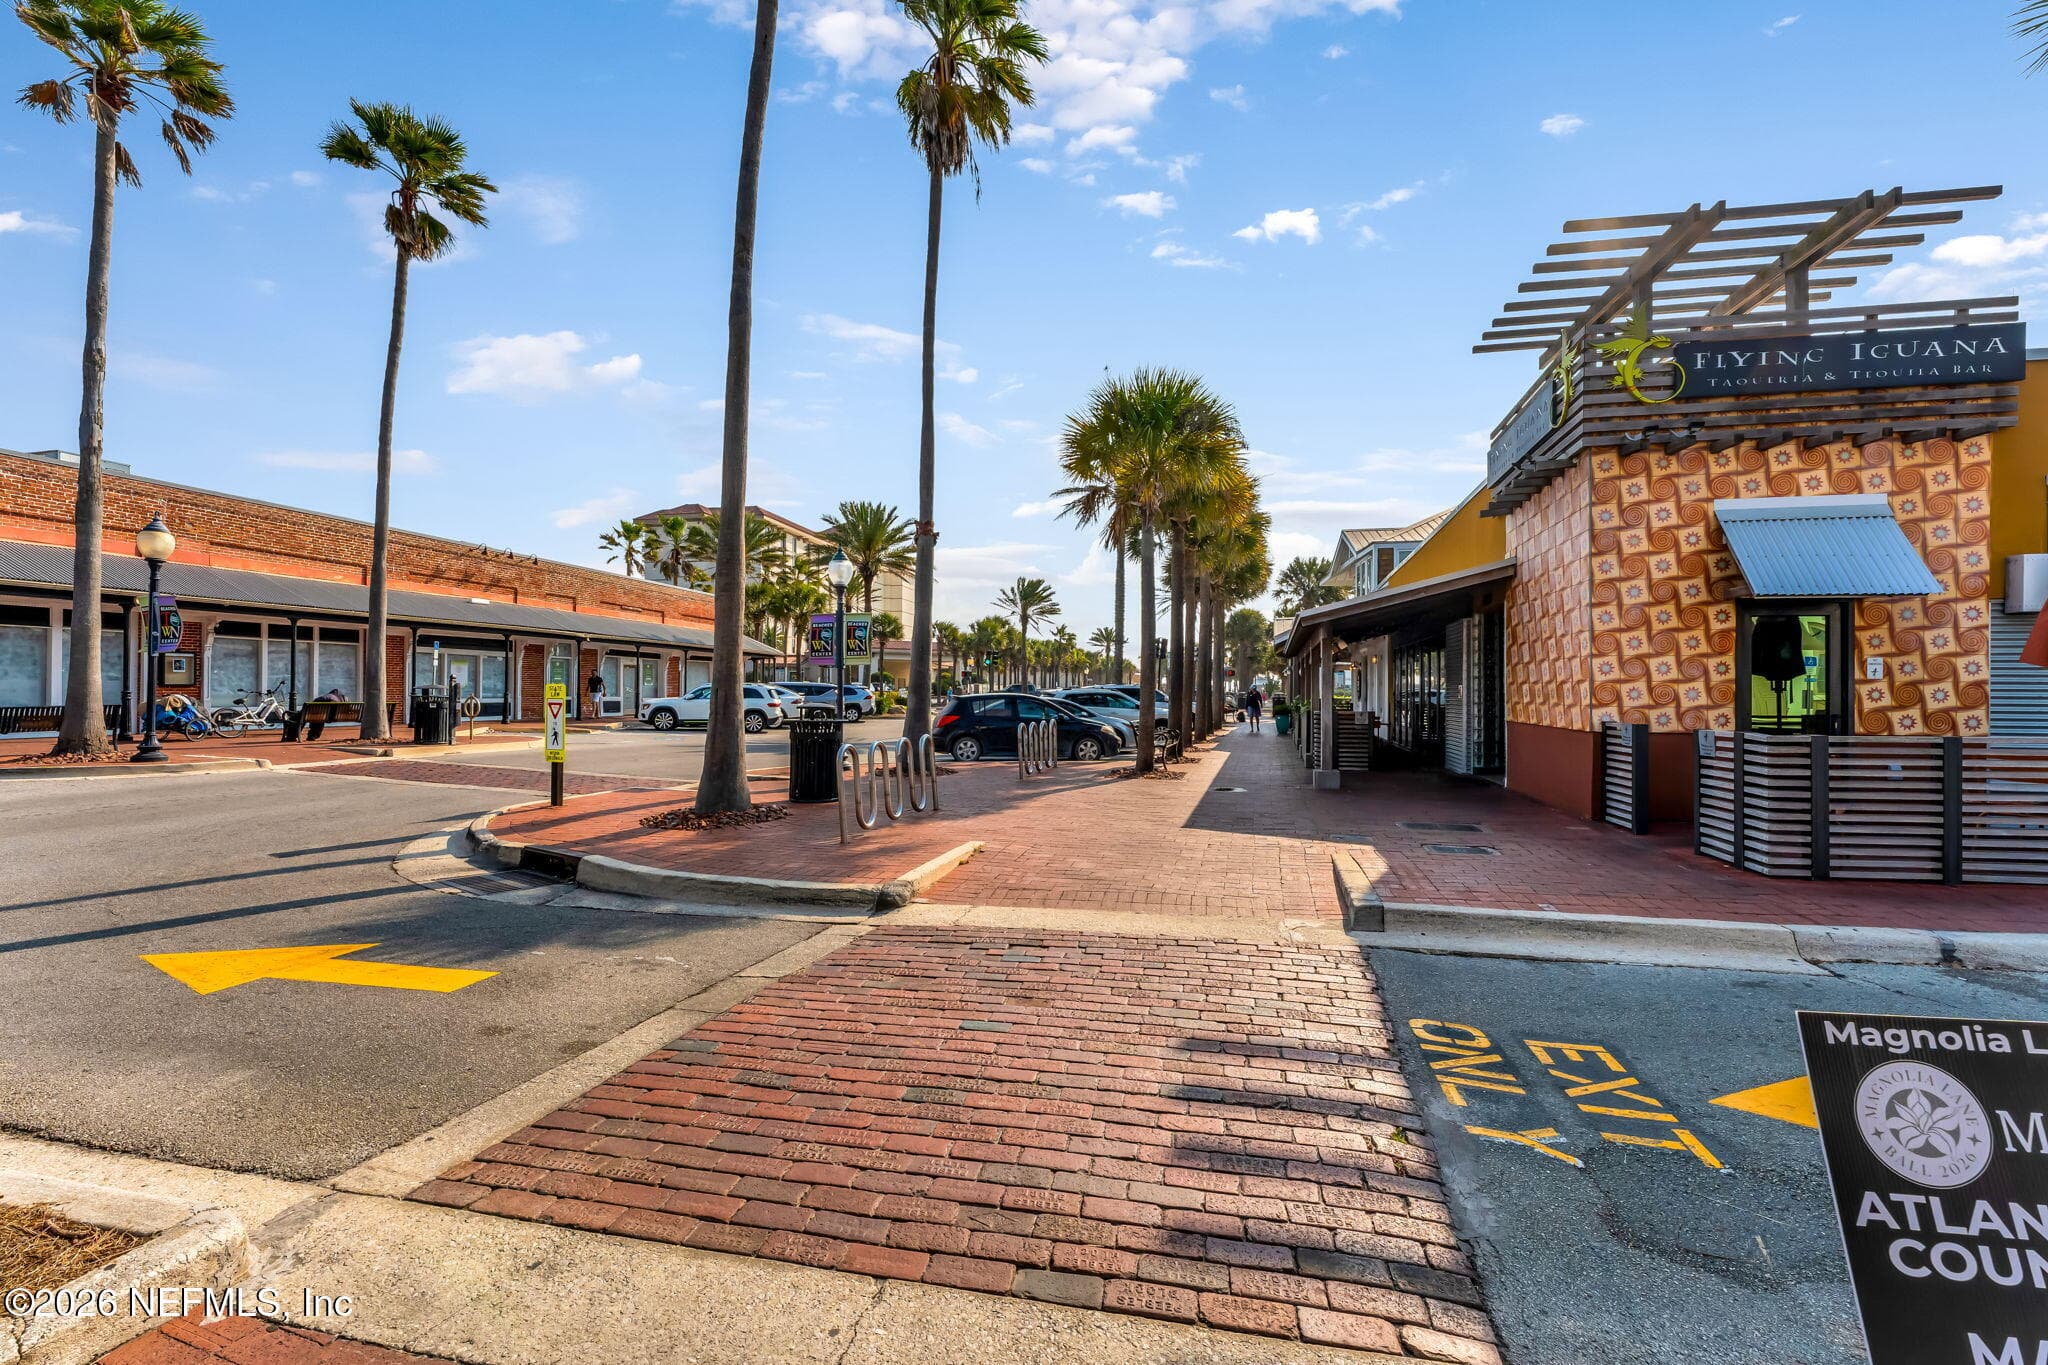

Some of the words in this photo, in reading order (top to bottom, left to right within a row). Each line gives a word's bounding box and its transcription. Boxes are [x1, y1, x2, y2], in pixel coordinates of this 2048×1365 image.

[1694, 348, 1824, 373] FLYING
[1850, 337, 2008, 361] IGUANA
[1824, 371, 1836, 381] &
[1953, 364, 1993, 374] BAR
[1823, 1020, 2012, 1054] Magnolia
[1408, 1018, 1585, 1168] ONLY
[1523, 1039, 1725, 1169] EXIT
[1864, 1069, 1935, 1119] MAGNOLIA
[1941, 1083, 1980, 1127] LANE
[1884, 1145, 1932, 1178] BALL
